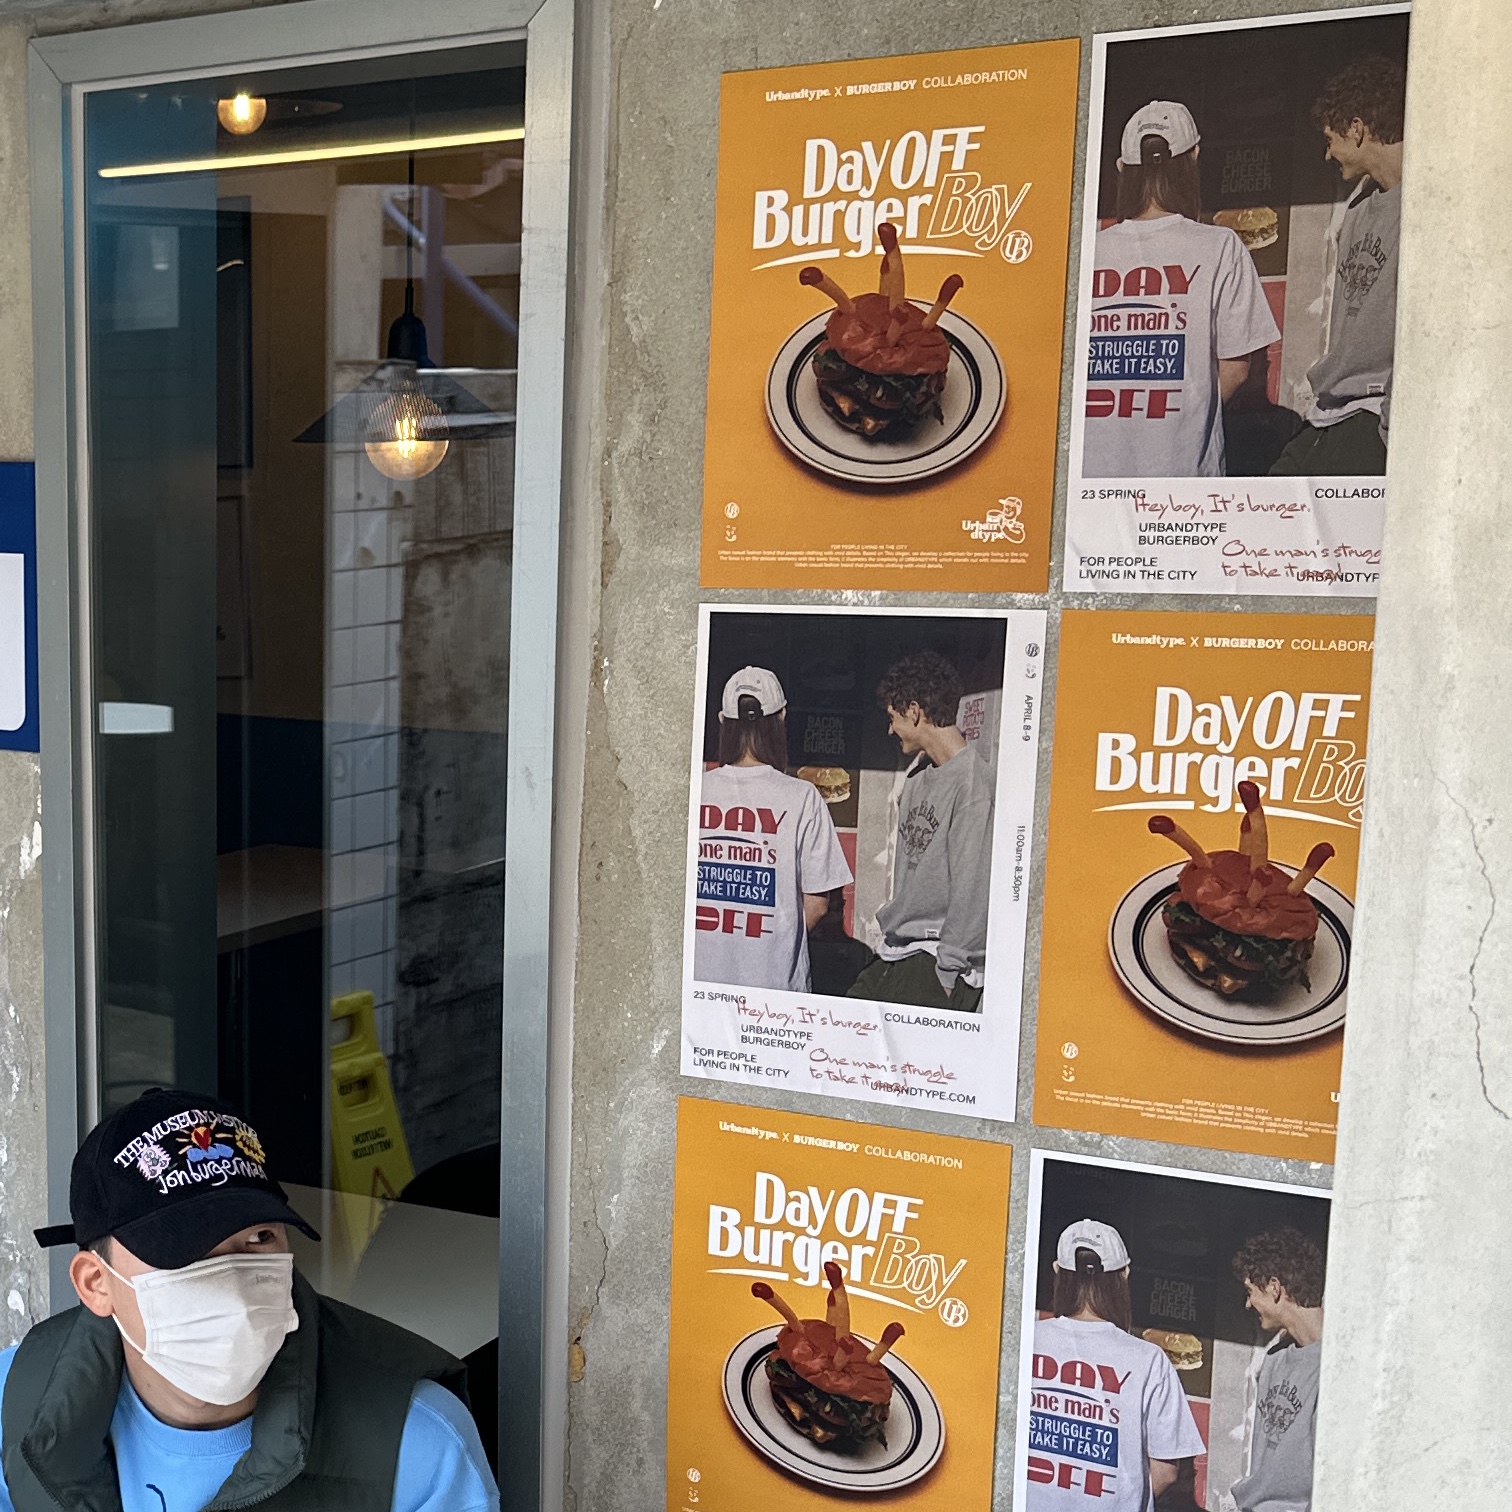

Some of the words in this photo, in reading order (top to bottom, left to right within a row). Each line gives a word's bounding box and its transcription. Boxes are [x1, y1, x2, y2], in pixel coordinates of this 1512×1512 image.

[834, 86, 842, 97] X
[846, 80, 917, 96] BURGERBOY
[922, 68, 1028, 88] COLLABORATION
[803, 138, 890, 198] Day
[890, 126, 985, 190] OFF
[753, 189, 933, 257] Burger
[926, 172, 1032, 250] Boy
[1092, 264, 1201, 299] DAY
[1127, 302, 1188, 331] man's
[1088, 340, 1156, 358] STRUGGLE
[1160, 340, 1179, 356] TO
[1088, 358, 1121, 374] TAKE
[1124, 358, 1138, 374] IT
[1140, 357, 1177, 374] EASY.
[1081, 490, 1096, 500] 23
[1098, 488, 1146, 500] SPRING
[1135, 495, 1170, 520] Hey
[1208, 494, 1244, 513] It's
[1139, 522, 1226, 533] URBANDTYPE
[1138, 535, 1218, 546] BURGERBOY
[1222, 540, 1272, 558] One
[1274, 540, 1329, 558] man's
[1080, 556, 1106, 567] FOR
[1108, 556, 1158, 567] PEOPLE
[1222, 562, 1238, 577] to
[1242, 561, 1281, 578] take
[1286, 563, 1298, 578] it
[1079, 570, 1121, 580] LIVING
[1123, 570, 1137, 580] IN
[1139, 570, 1164, 580] THE
[1167, 570, 1198, 581] CITY
[1190, 636, 1199, 647] X
[1204, 637, 1284, 649] BURGERBOY
[1023, 694, 1034, 722] APRIL
[1153, 686, 1253, 754] Day
[1252, 690, 1362, 750] OFF
[1022, 724, 1032, 742] 8-9
[1095, 732, 1302, 813] Burger
[1293, 738, 1368, 822] Bo
[700, 804, 788, 834] DAY
[728, 840, 777, 864] man's
[698, 866, 752, 884] STRUGGLE
[755, 870, 770, 884] TO
[698, 881, 724, 896] TAKE
[726, 884, 738, 897] IT
[739, 886, 769, 901] EASY.
[693, 990, 705, 1000] 23
[708, 991, 747, 1004] SPRING
[738, 1002, 764, 1024] Hey
[796, 1006, 828, 1025] It's
[884, 1012, 980, 1033] COLLABORATION
[741, 1024, 813, 1041] URBANDTYPE
[741, 1035, 806, 1050] BURGERBOY
[693, 1047, 714, 1057] FOR
[717, 1050, 758, 1063] PEOPLE
[810, 1048, 849, 1066] One
[852, 1056, 898, 1072] man's
[901, 1062, 957, 1084] struggle
[693, 1057, 727, 1070] LIVING
[730, 1062, 740, 1072] IN
[743, 1064, 763, 1074] THE
[766, 1068, 790, 1078] CITY
[809, 1067, 823, 1079] to
[824, 1067, 858, 1084] take
[862, 1073, 872, 1086] it
[114, 1137, 148, 1169] THE
[143, 1108, 213, 1144] MUSEUM
[782, 1132, 790, 1143] X
[793, 1134, 860, 1153] BURGERBOY
[865, 1144, 963, 1170] COLLABORATION
[754, 1171, 835, 1236] Day
[834, 1188, 924, 1242] OFF
[708, 1204, 876, 1286] Burger
[870, 1232, 968, 1309] Boy
[1032, 1353, 1132, 1394] DAY
[1064, 1398, 1120, 1425] man's
[1029, 1415, 1092, 1440] STRUGGLE
[1095, 1428, 1113, 1445] TO
[1029, 1430, 1059, 1449] TAKE
[1062, 1437, 1075, 1452] IT
[1076, 1439, 1111, 1461] EASY.
